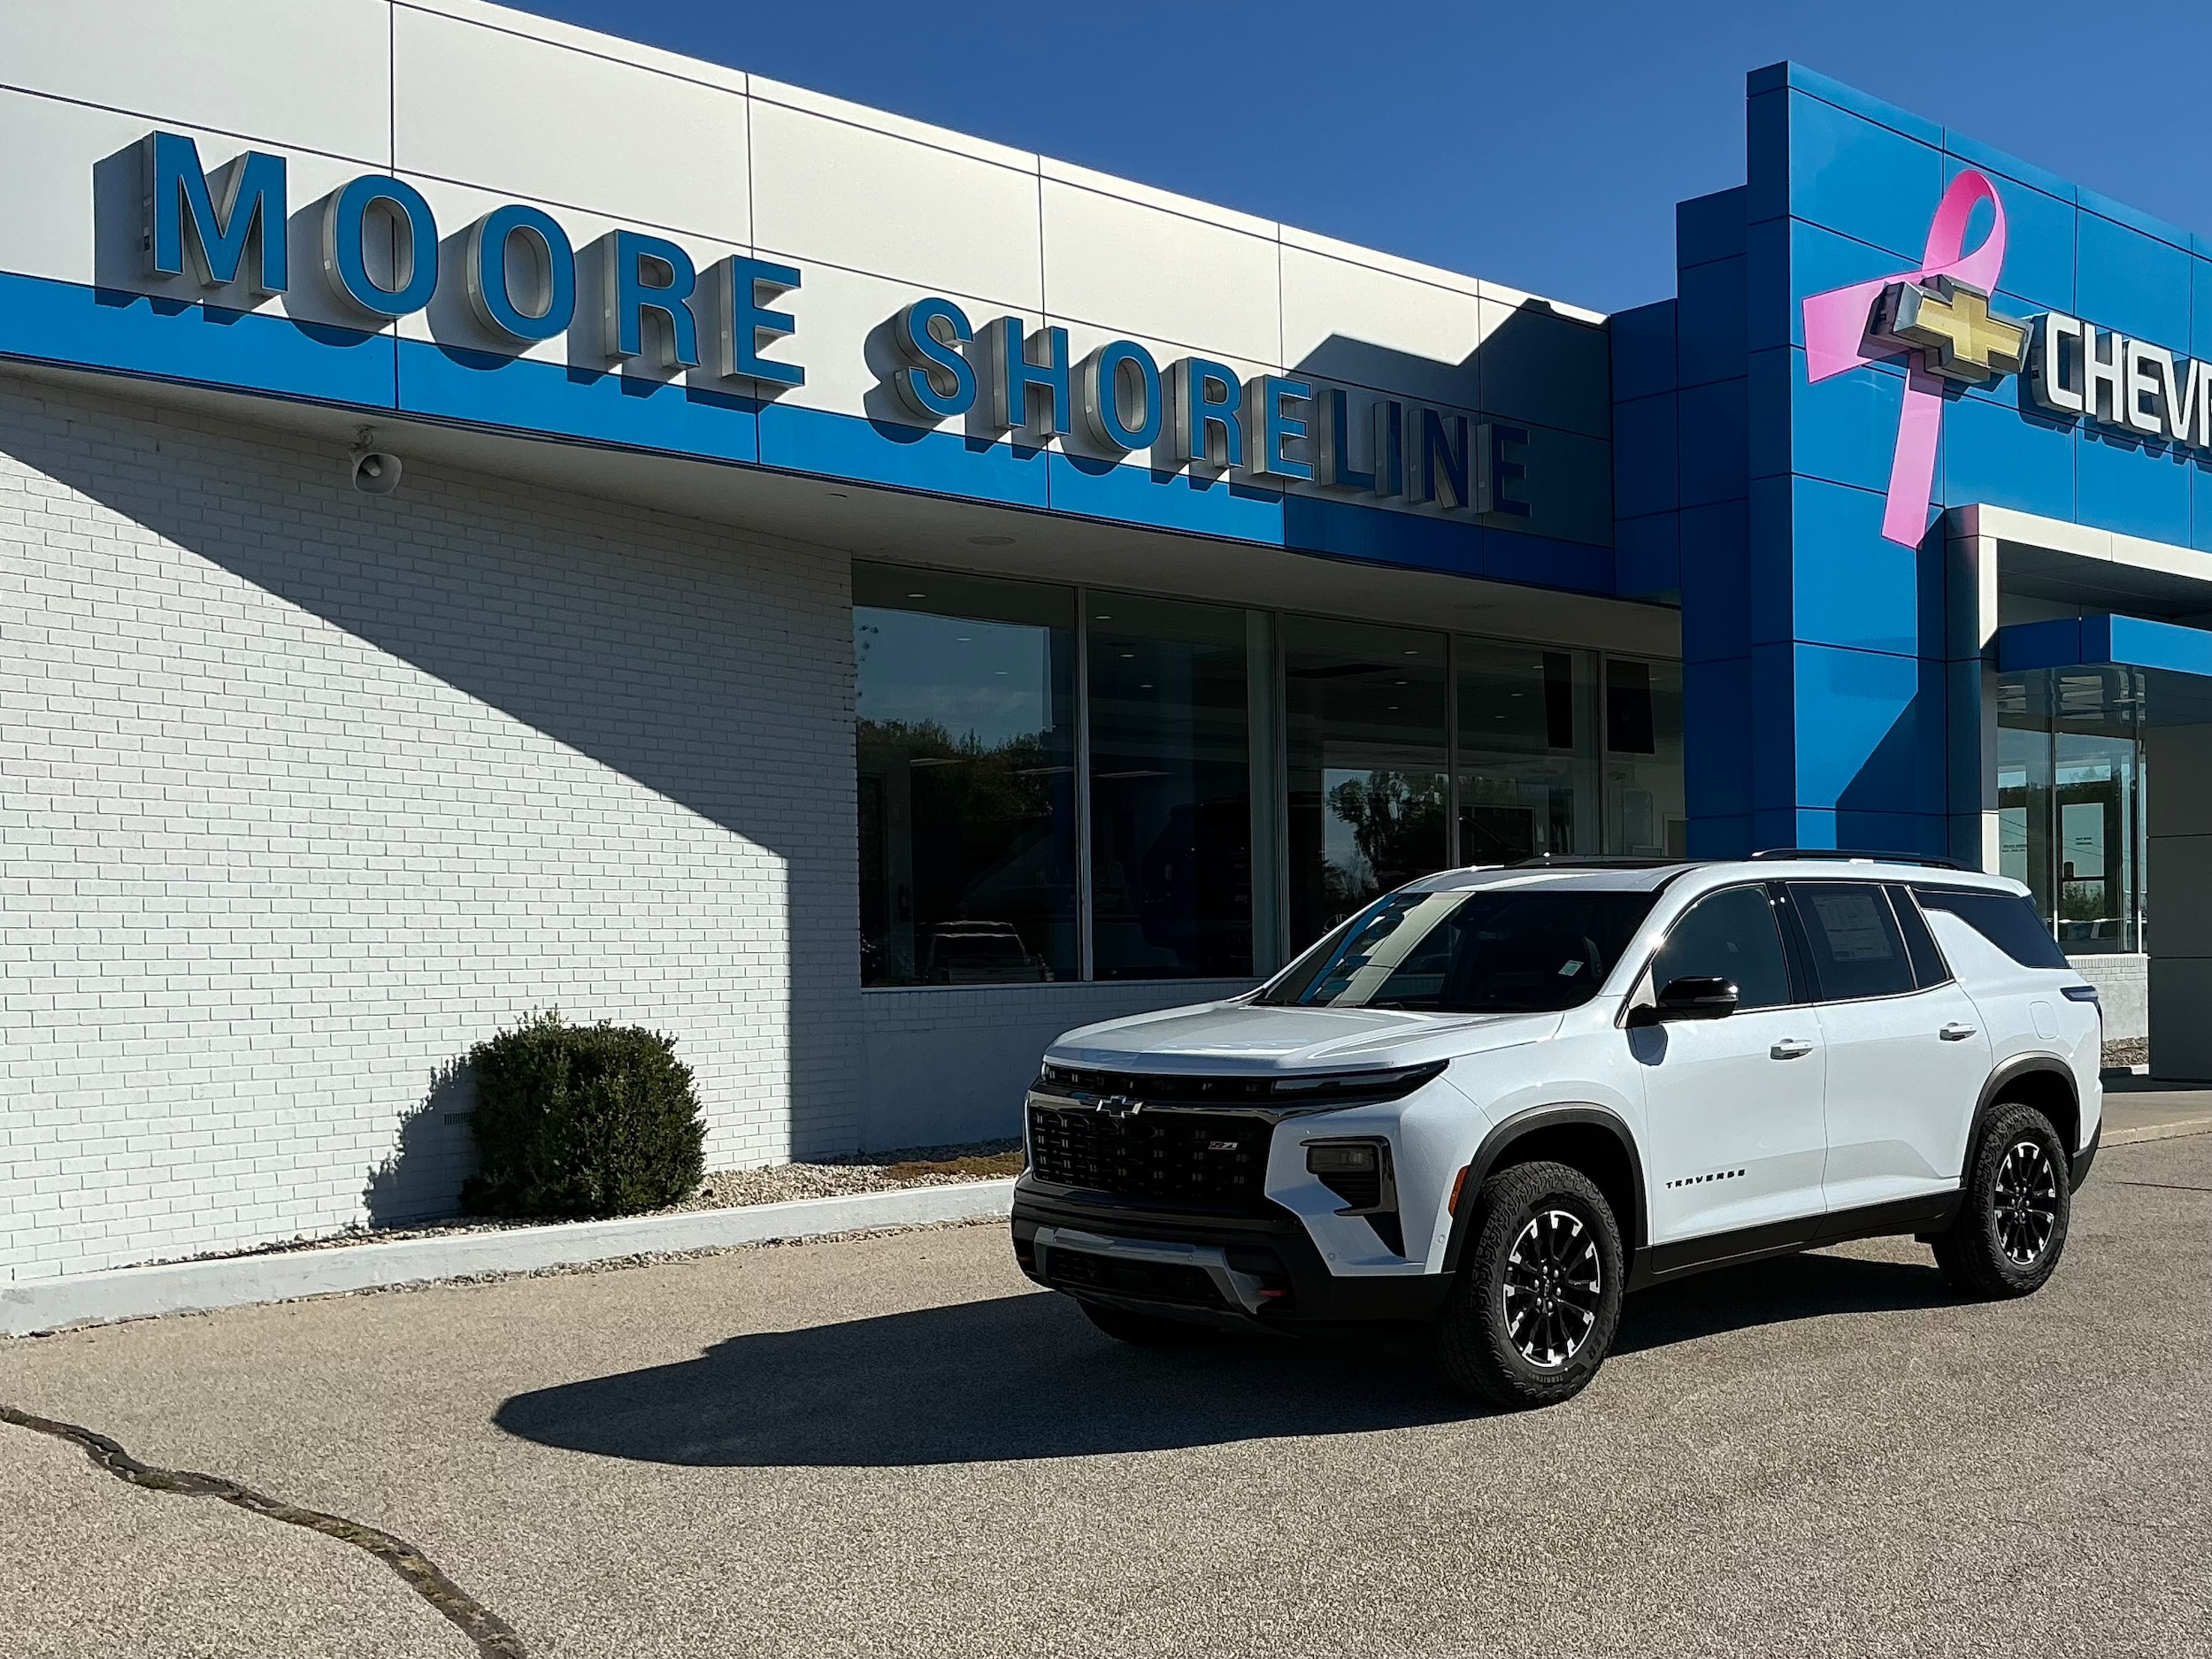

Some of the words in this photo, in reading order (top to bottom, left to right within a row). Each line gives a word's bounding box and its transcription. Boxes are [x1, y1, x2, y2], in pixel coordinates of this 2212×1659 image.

[149, 130, 805, 388] MOORE
[901, 297, 1532, 517] SHORELINE
[1665, 1169, 1746, 1189] TRAVERSE
